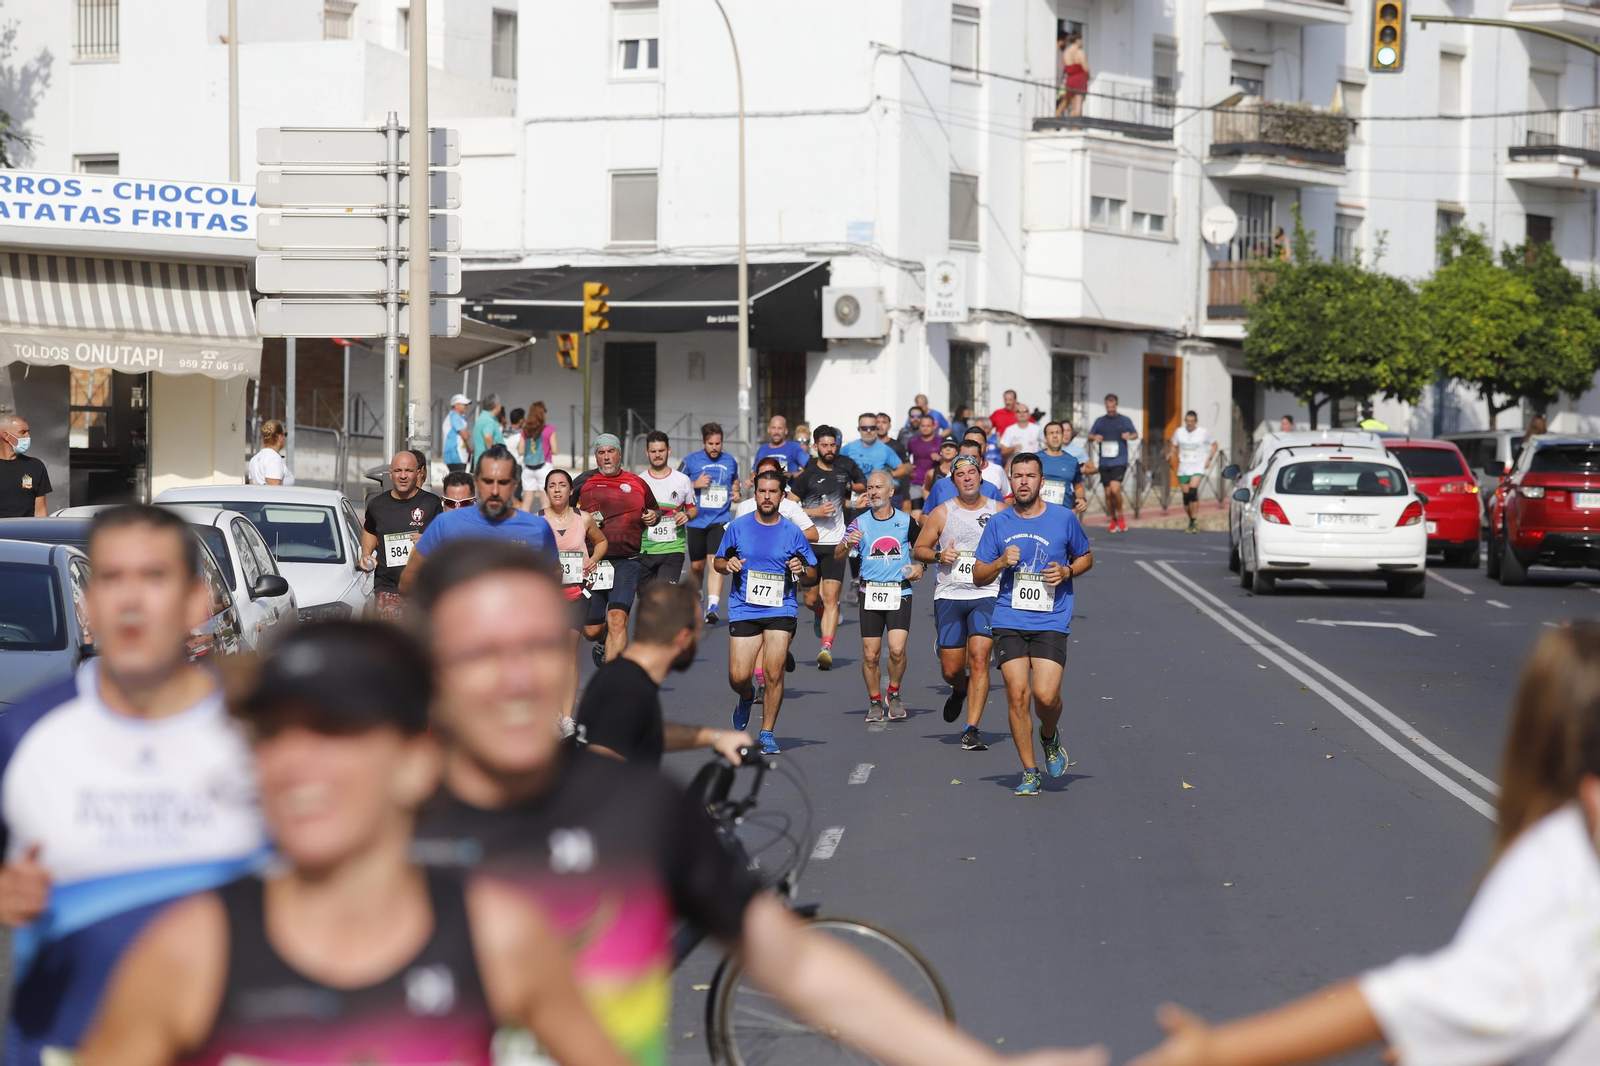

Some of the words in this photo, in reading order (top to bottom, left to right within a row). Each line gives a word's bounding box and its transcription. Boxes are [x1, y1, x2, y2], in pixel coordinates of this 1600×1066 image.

[132, 209, 248, 232] FRITAS
[14, 344, 69, 360] TOLDOS
[75, 343, 163, 367] ONUTAPI
[179, 359, 198, 369] 959
[201, 361, 213, 370] 27
[216, 361, 229, 371] 06
[705, 494, 719, 502] 418
[1042, 490, 1056, 498] 481
[653, 527, 668, 536] 495
[391, 545, 409, 558] 584
[589, 573, 604, 582] 474
[752, 585, 772, 597] 477
[1020, 587, 1041, 601] 600
[872, 592, 888, 602] 667
